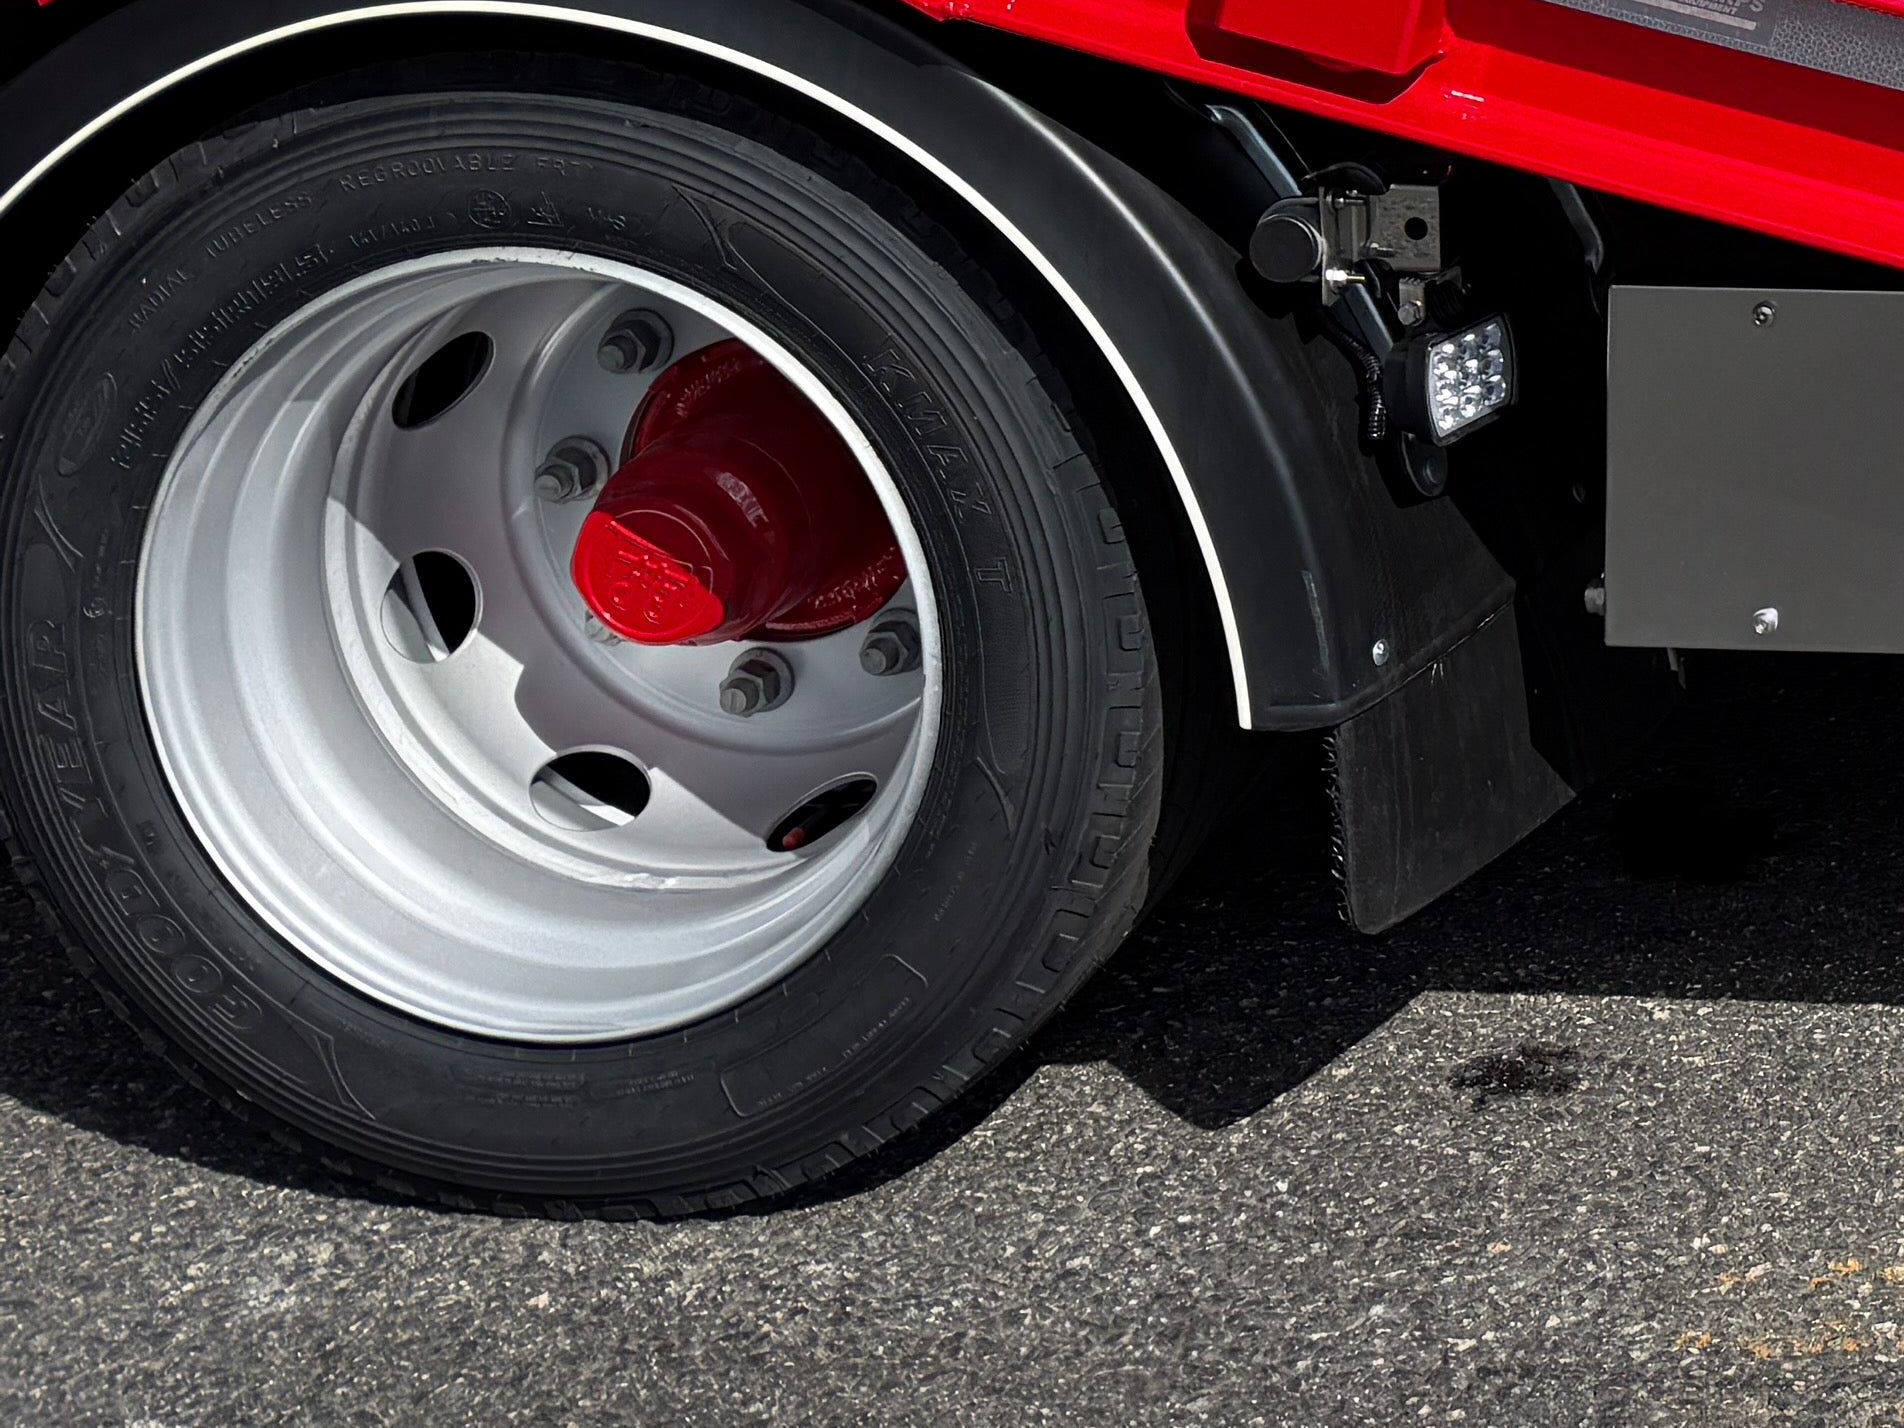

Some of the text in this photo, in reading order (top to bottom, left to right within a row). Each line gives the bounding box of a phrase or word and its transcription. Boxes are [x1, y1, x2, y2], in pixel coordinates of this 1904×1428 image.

[337, 153, 517, 192] REGROOVABLE
[861, 348, 1013, 594] KMAX T
